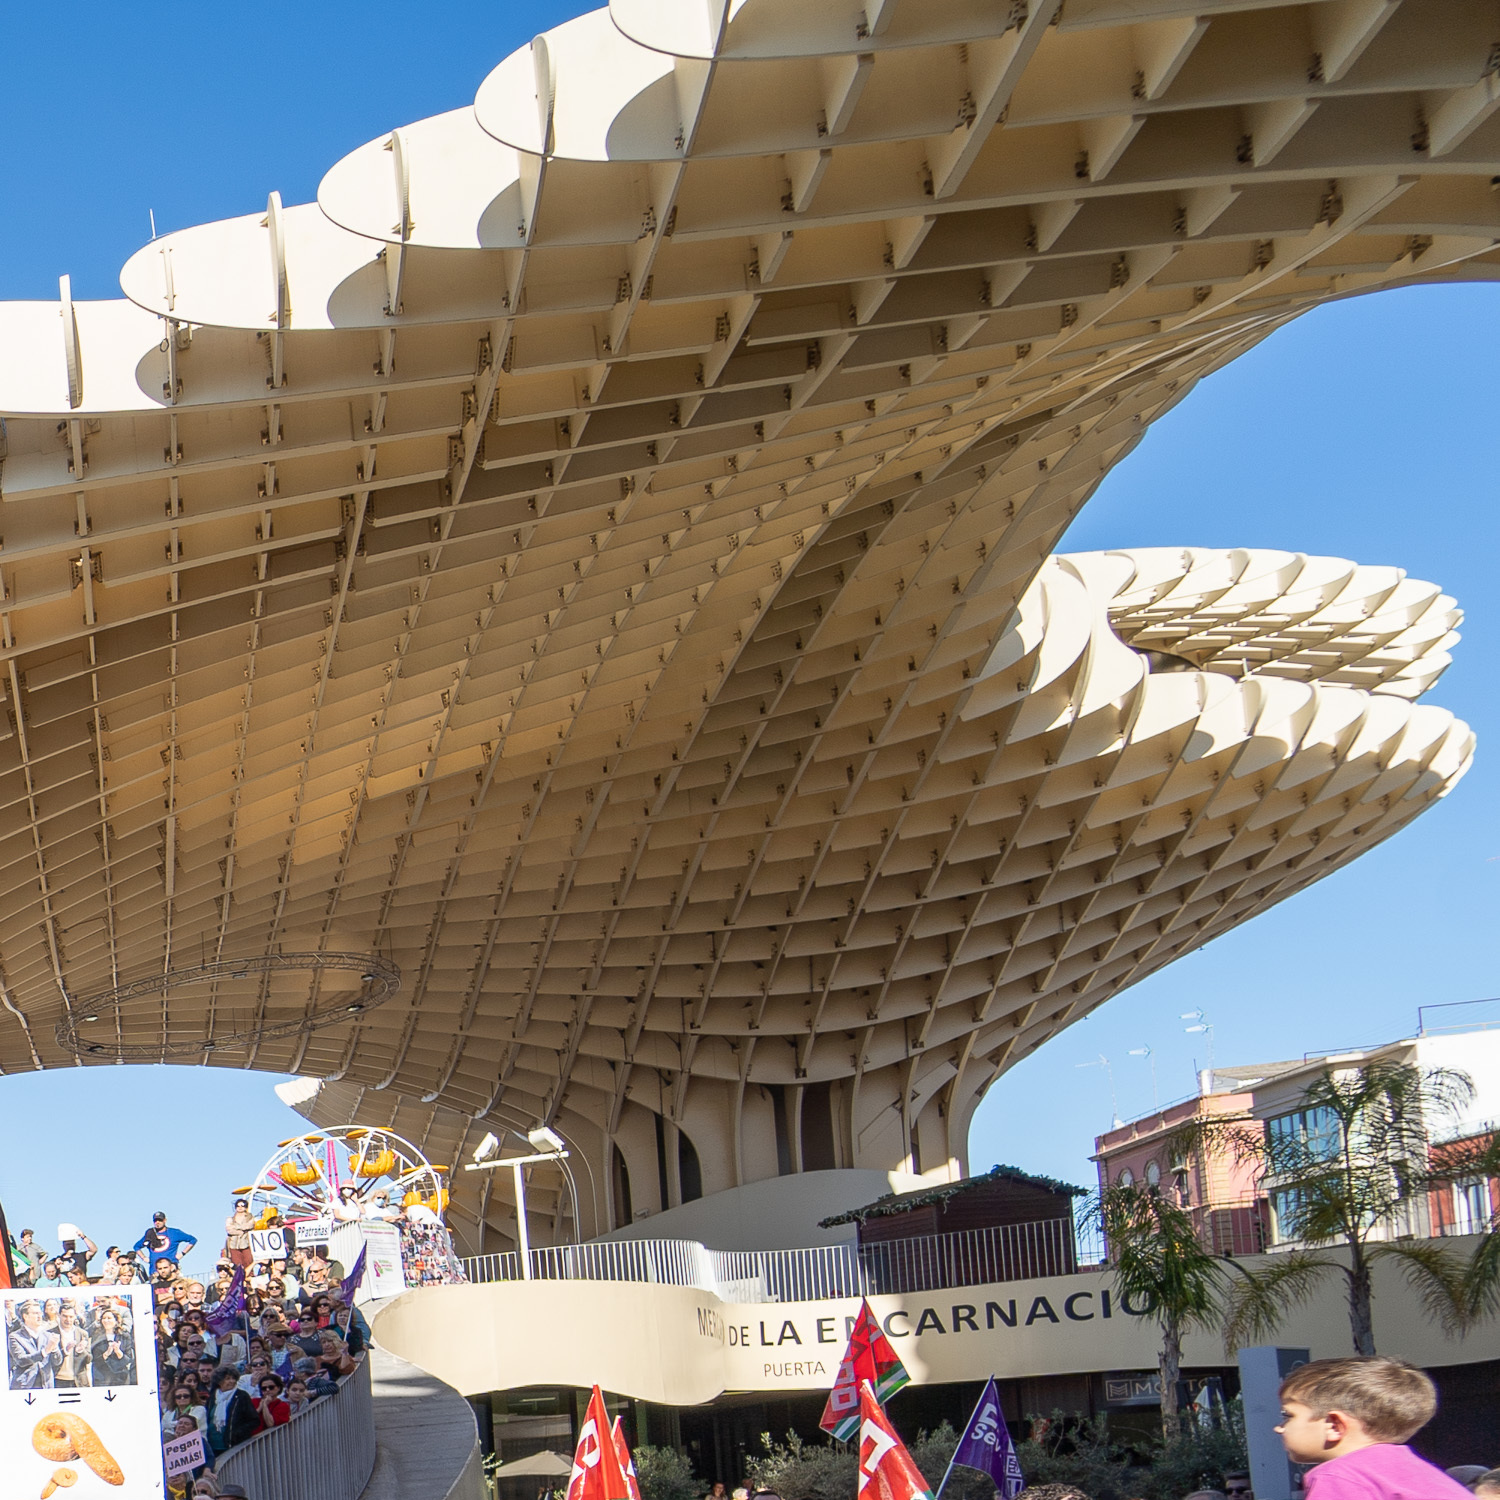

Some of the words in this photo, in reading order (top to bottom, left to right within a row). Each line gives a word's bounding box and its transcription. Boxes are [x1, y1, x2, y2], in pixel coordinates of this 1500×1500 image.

[251, 1230, 282, 1252] NO
[728, 1325, 750, 1347] DE
[759, 1320, 803, 1347] LA
[815, 1289, 1160, 1344] ENCARNACIO
[763, 1360, 826, 1378] PUERTA
[165, 1437, 200, 1457] Pegar,
